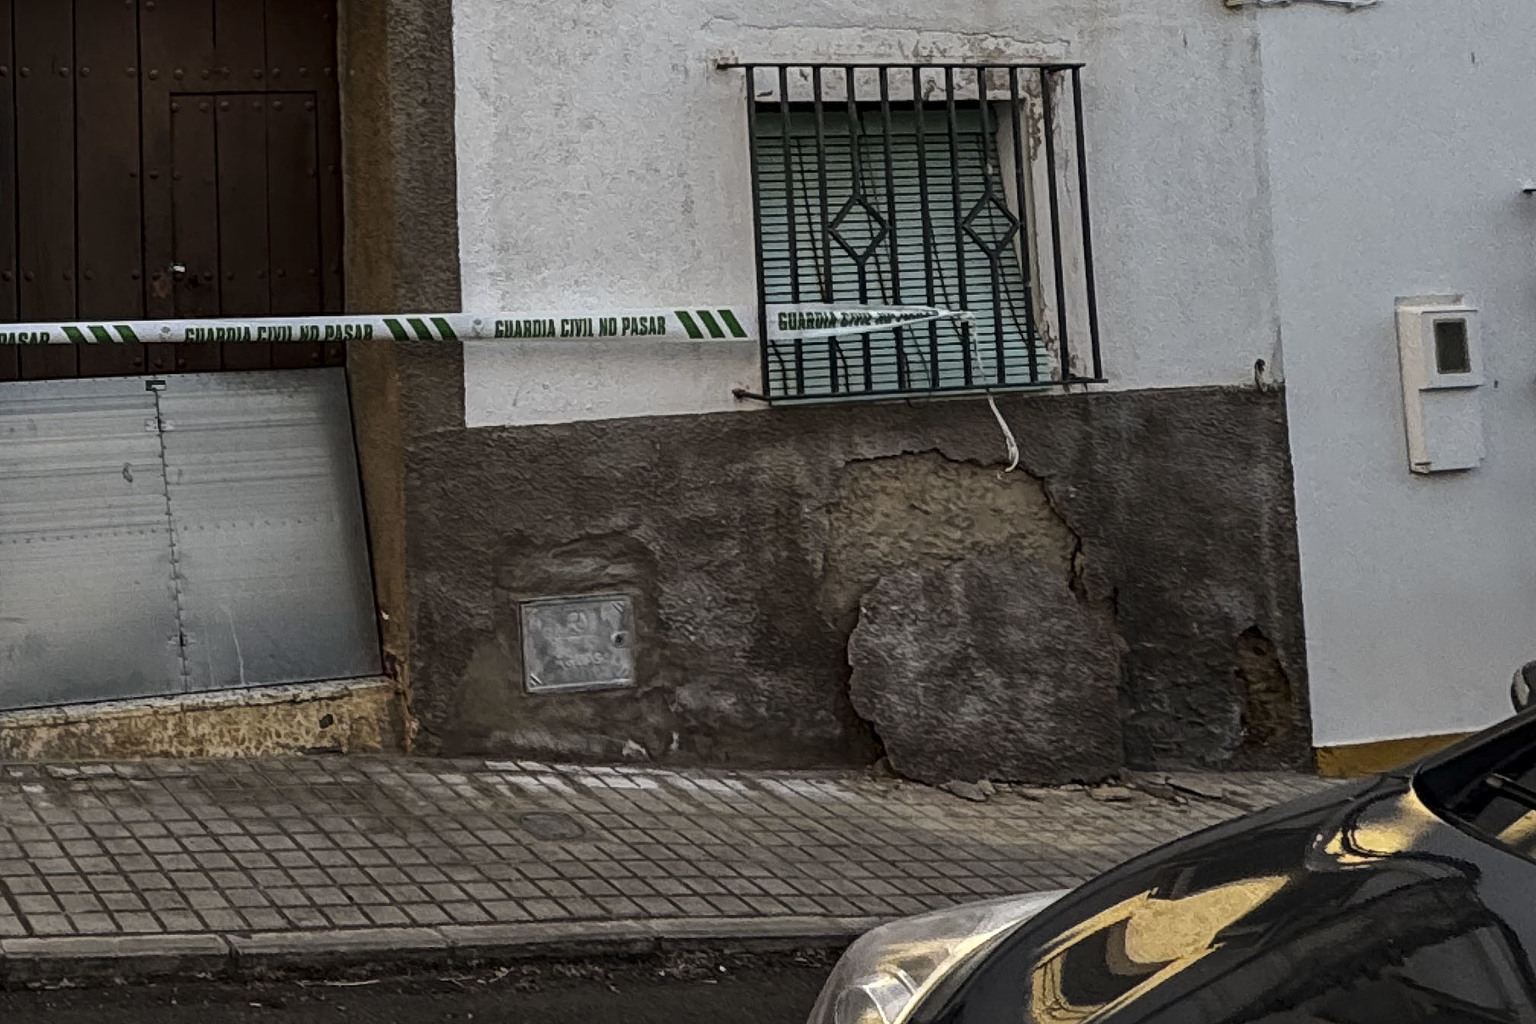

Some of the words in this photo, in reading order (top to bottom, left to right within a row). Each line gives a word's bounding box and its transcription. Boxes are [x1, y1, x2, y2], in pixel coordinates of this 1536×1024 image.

[494, 318, 556, 338] GUARDIA
[560, 317, 594, 337] CIVIL
[599, 317, 617, 337] NO
[621, 316, 666, 336] PASAR
[778, 312, 838, 330] GUARDIA
[184, 326, 251, 342] GUARDIA
[257, 325, 293, 342] CIVIL
[299, 324, 322, 341] NO
[324, 323, 373, 341] PASAR
